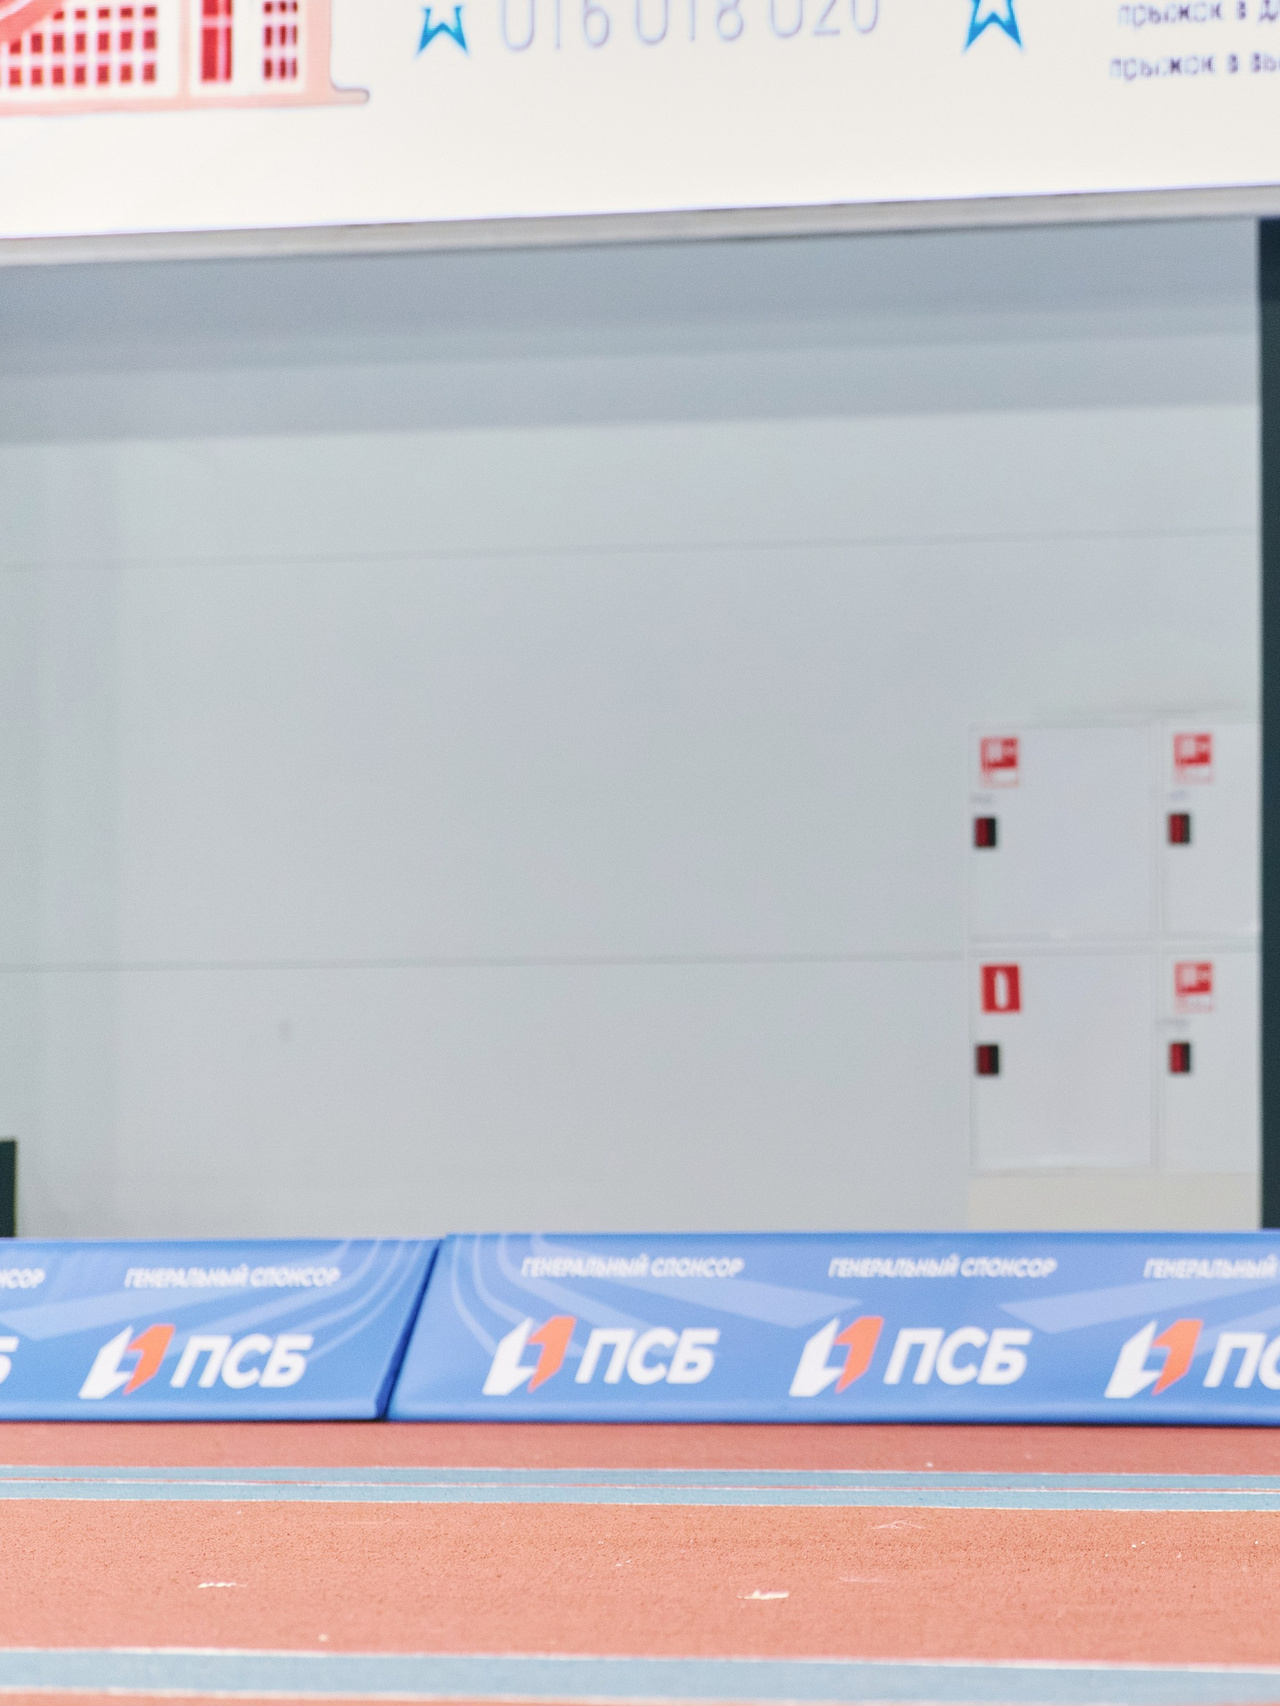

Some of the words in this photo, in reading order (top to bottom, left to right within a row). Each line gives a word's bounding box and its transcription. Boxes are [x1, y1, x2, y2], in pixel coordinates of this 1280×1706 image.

[124, 1264, 249, 1288] ГЕНЕРАЛЬНЫЙ
[251, 1267, 341, 1287] СПОНСОР
[521, 1254, 648, 1278] ГЕНЕРАЛЬНЫЙ
[650, 1257, 744, 1278] СПОНСОР
[828, 1255, 957, 1278] ГЕНЕРАЛЬНЫЙ
[961, 1257, 1057, 1277] СПОНСОР
[1144, 1255, 1276, 1279] ГЕНЕРАЛЬНЫЙ
[171, 1335, 313, 1388] ПСБ
[576, 1328, 720, 1384] ПСБ
[884, 1327, 1032, 1385] ПСБ
